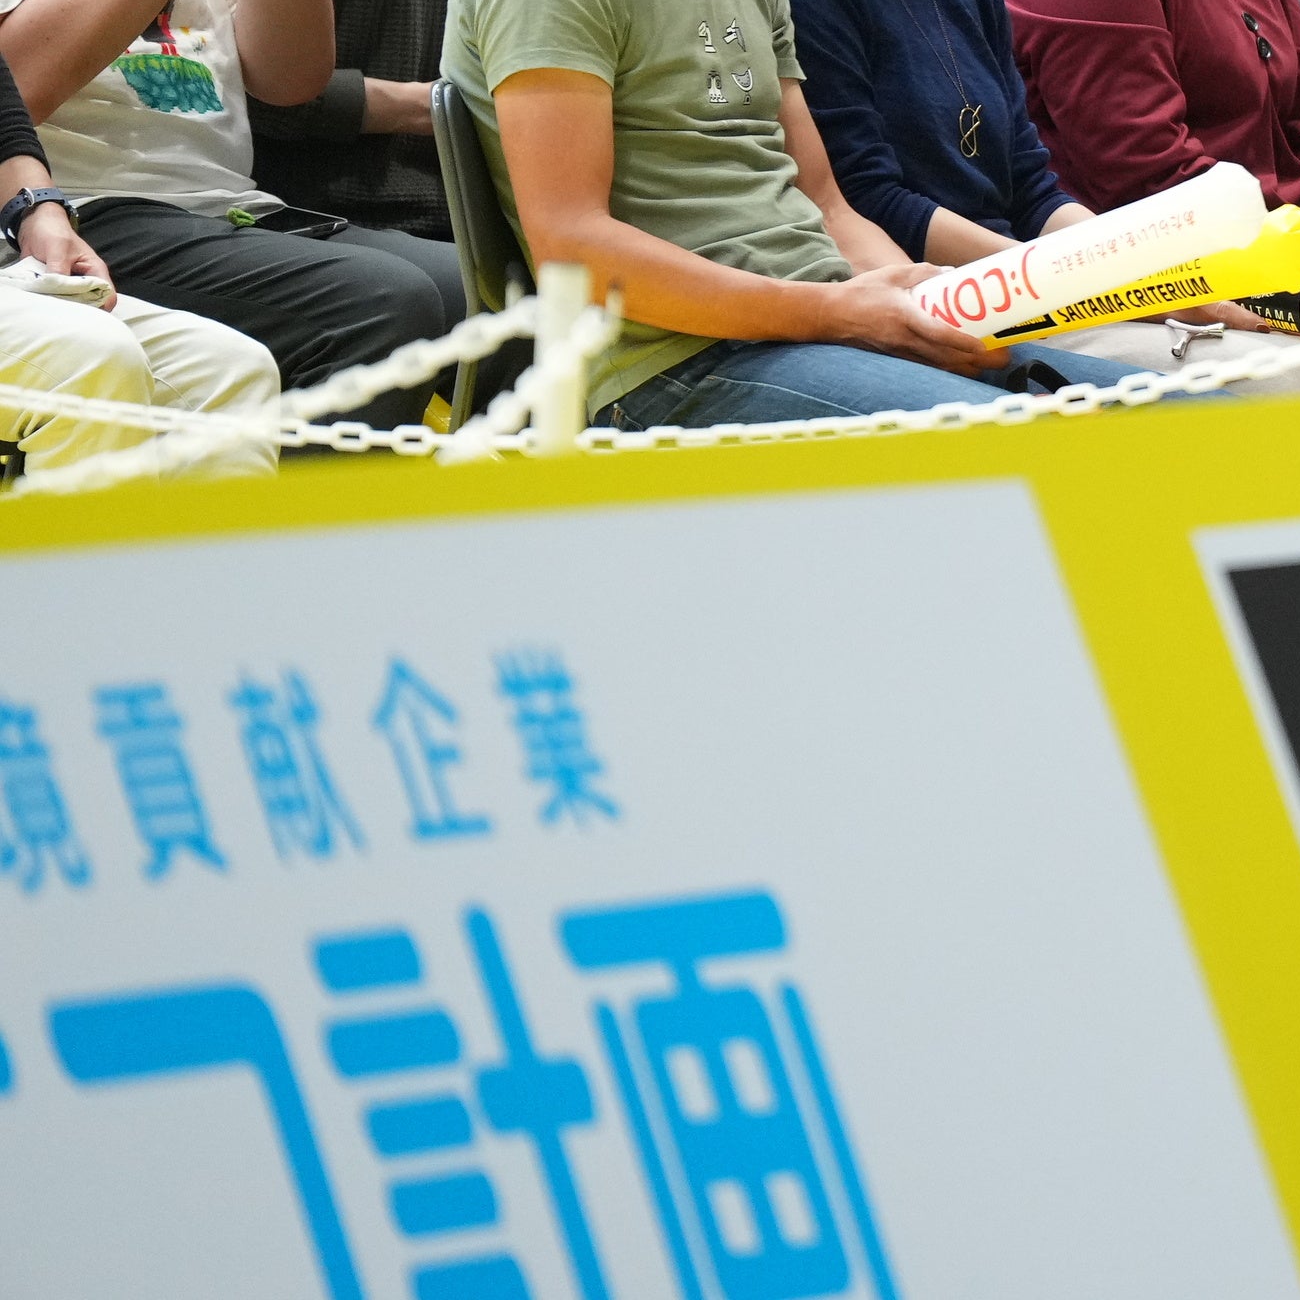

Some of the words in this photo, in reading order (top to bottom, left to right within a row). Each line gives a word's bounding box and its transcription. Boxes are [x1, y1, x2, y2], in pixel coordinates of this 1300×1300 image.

[1057, 293, 1130, 323] SAITAMA
[1126, 276, 1214, 309] CRITERIUM
[1240, 302, 1295, 322] AITAMA
